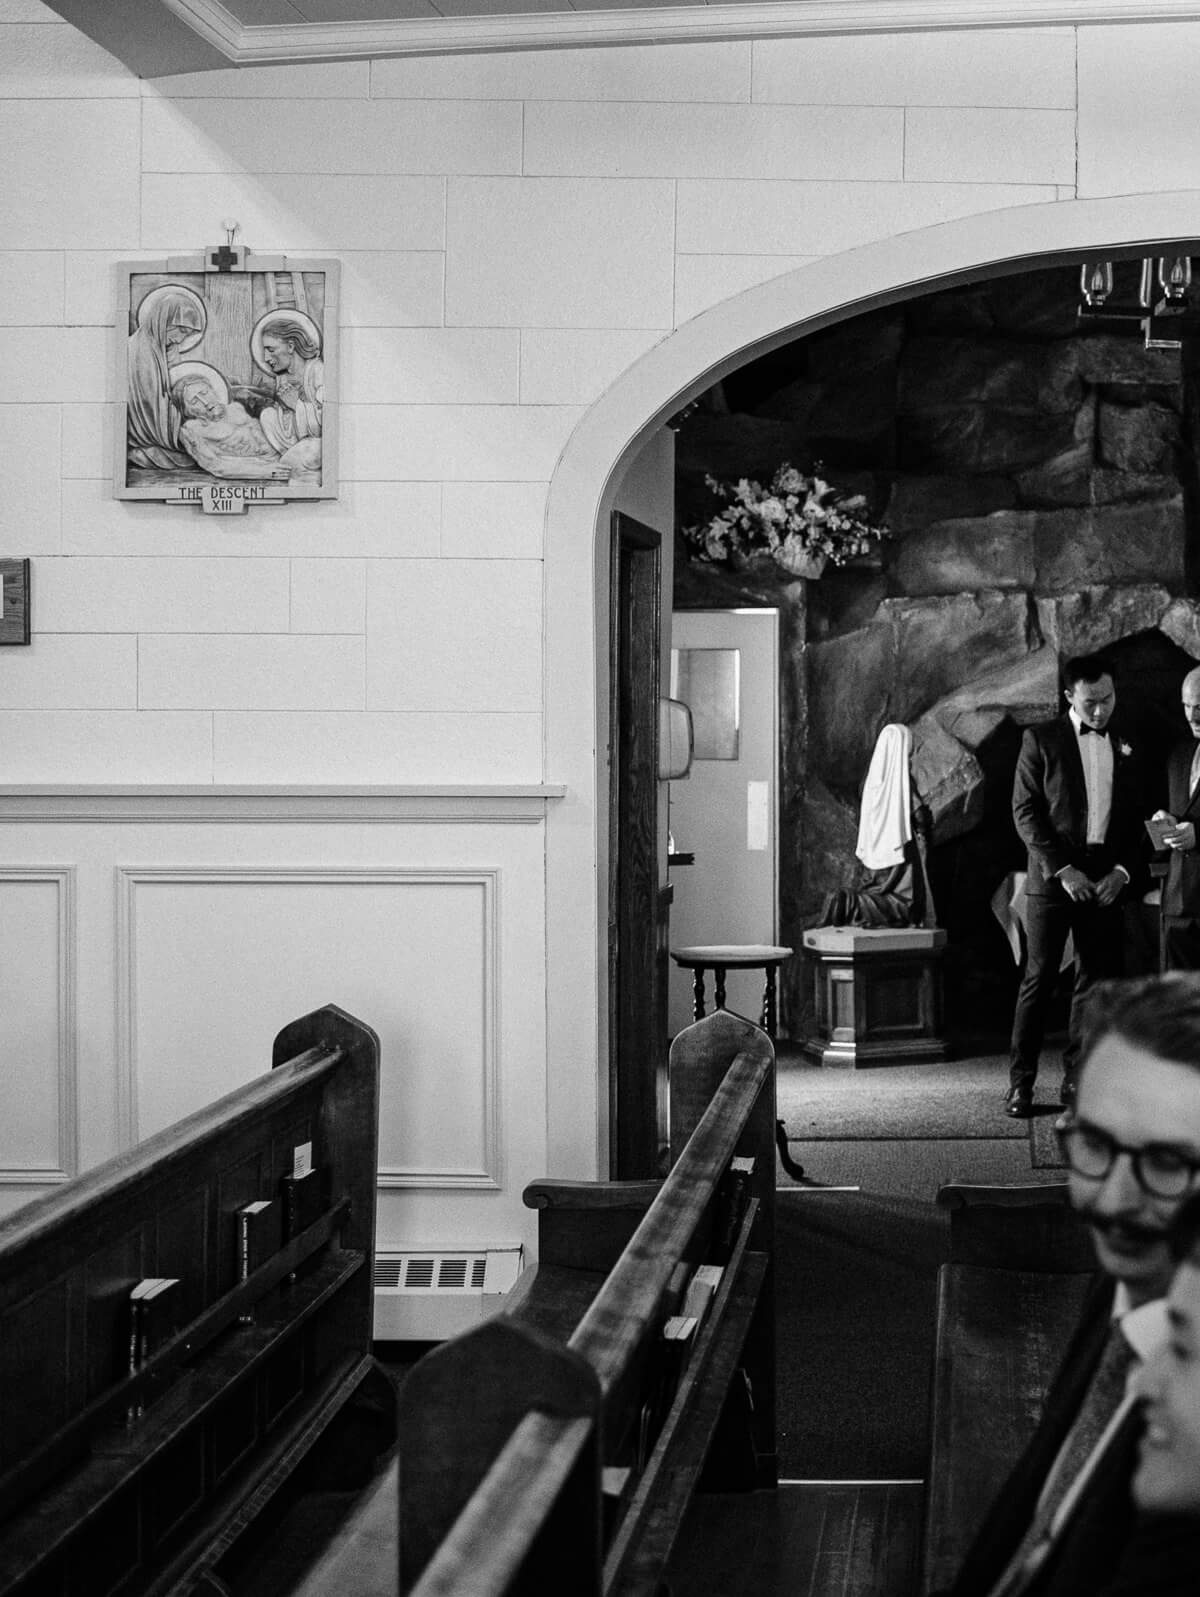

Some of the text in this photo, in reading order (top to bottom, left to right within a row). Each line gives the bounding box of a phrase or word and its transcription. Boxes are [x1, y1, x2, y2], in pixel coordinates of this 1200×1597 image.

[179, 487, 266, 499] THE DESCENT
[212, 500, 232, 512] XIII
